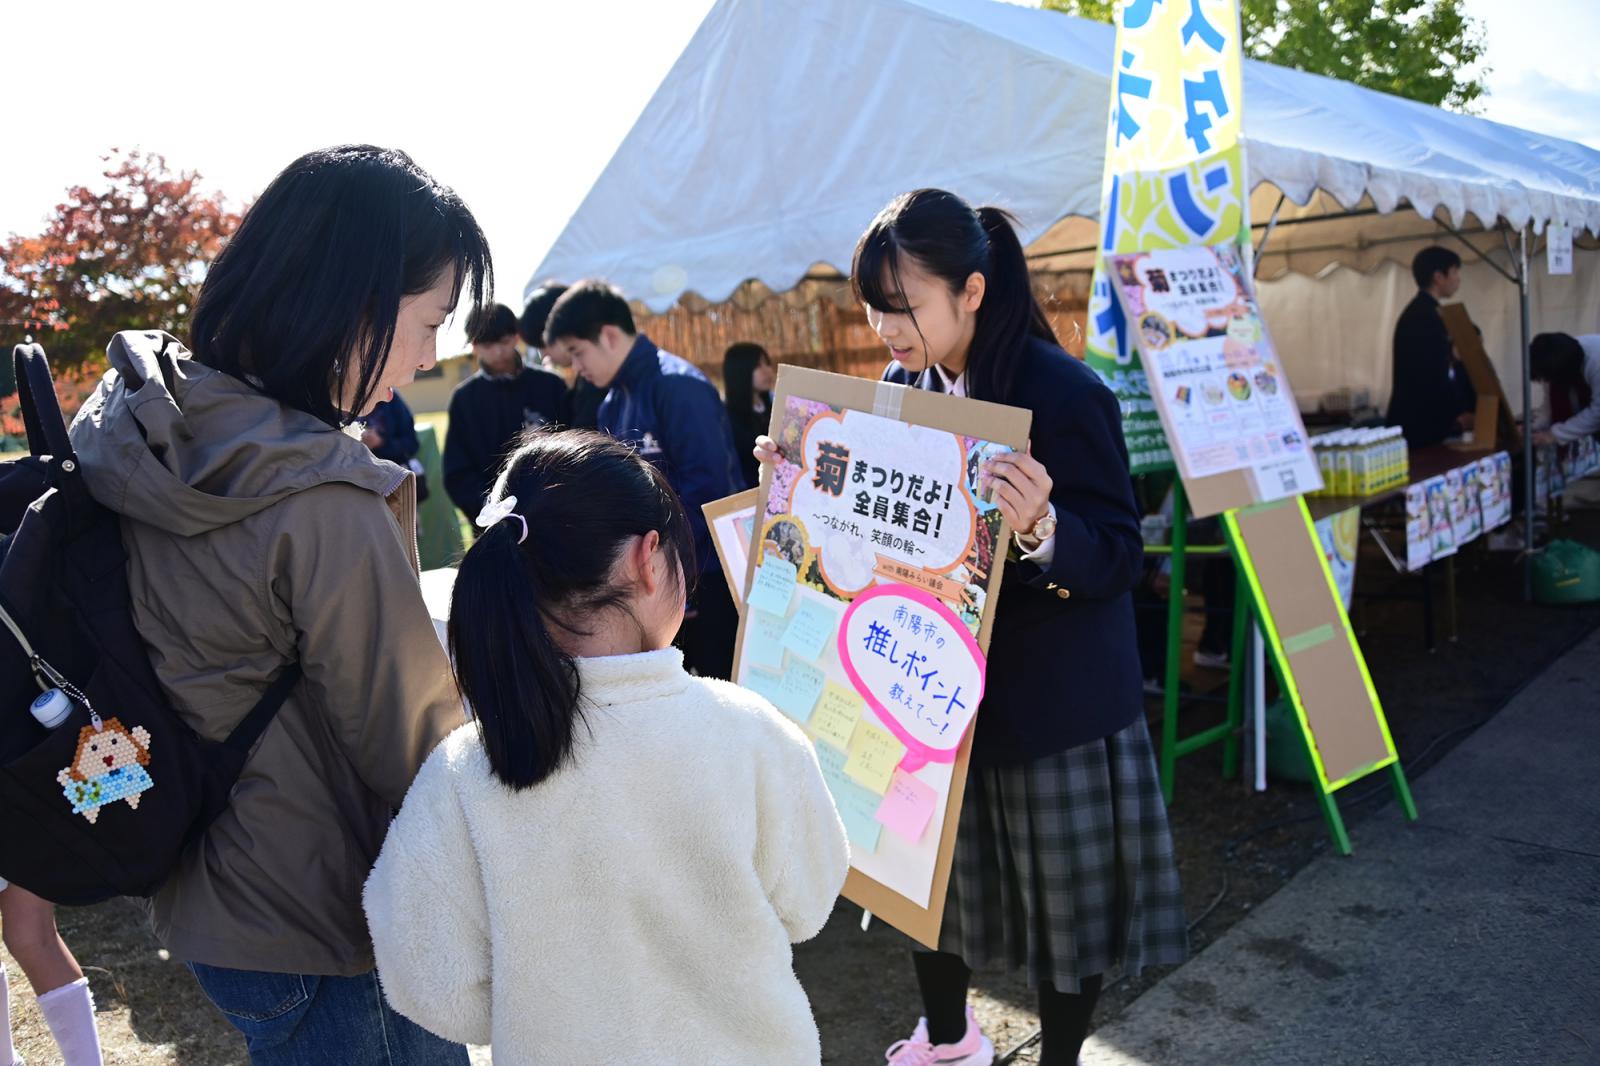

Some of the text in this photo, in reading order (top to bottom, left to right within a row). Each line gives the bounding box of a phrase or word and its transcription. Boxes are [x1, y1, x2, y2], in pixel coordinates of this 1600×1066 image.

[853, 491, 943, 538] 全員集合!
[893, 604, 945, 649] 南陽市の
[863, 620, 965, 714] 推しポイント
